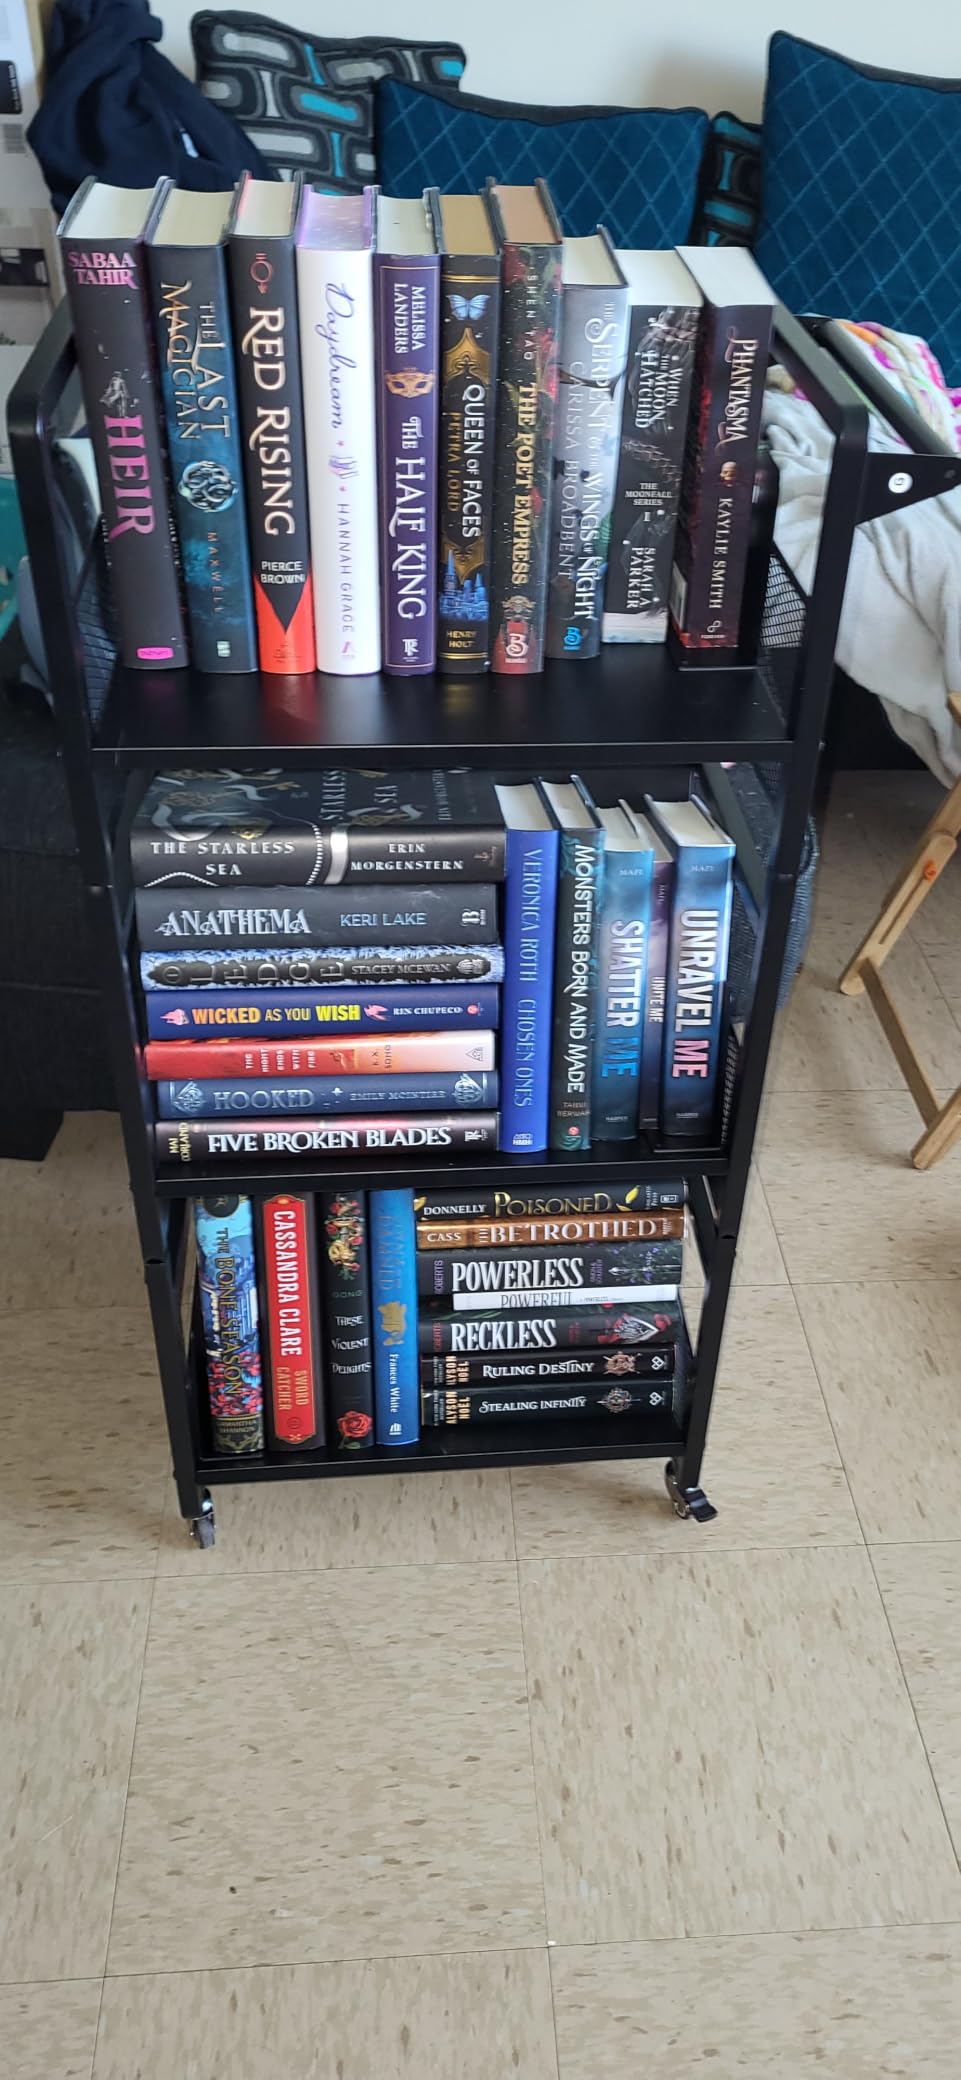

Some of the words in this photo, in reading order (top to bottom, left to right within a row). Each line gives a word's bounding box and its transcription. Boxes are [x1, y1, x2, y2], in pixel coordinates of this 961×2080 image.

[68, 251, 137, 268] SABAA
[73, 269, 139, 290] TAHIR
[526, 275, 538, 318] SHEN
[200, 302, 217, 338] THE
[394, 283, 409, 354] LANDERS
[411, 286, 427, 351] MELISSA
[159, 280, 202, 440] MAGICIAN
[241, 307, 286, 392] RED
[314, 283, 358, 429] Daydream
[524, 331, 537, 361] TAO
[191, 326, 231, 438] LAST
[585, 318, 620, 429] SERPENT
[635, 349, 660, 428] HATCHED
[666, 367, 684, 407] WHEN
[717, 332, 759, 447] PHANTASMA
[517, 382, 540, 426] THE
[565, 361, 586, 449] CARISSA
[650, 372, 669, 421] MOON
[401, 416, 424, 449] THE
[448, 411, 463, 463] PETRA
[462, 384, 486, 454] QUEEN
[104, 415, 156, 539] HEIR
[249, 406, 296, 536] RISING
[514, 432, 538, 489] POET
[388, 457, 427, 537] HALF
[448, 470, 461, 512] LORD
[462, 480, 483, 538] FACES
[579, 472, 603, 543] WINGS
[625, 490, 672, 498] MOONFALL
[633, 498, 663, 506] SERIES
[337, 504, 353, 574] HANNAH
[511, 495, 534, 585] EMPRESS
[557, 460, 581, 580] BROADBENT
[713, 498, 733, 555] KAYLIE
[207, 532, 224, 614] MAXWELL
[260, 574, 305, 584] BROWN
[261, 561, 303, 571] PIERCE
[391, 543, 427, 620] KING
[626, 547, 644, 609] PARKER
[640, 547, 657, 592] SARAH
[709, 560, 727, 609] SMITH
[339, 583, 355, 633] GRACE
[573, 556, 604, 620] NIGHT
[320, 769, 347, 821] STARLESS
[151, 842, 187, 854] THE
[198, 842, 295, 854] STARLESS
[351, 861, 464, 870] MORGENSTERN
[388, 844, 425, 854] ERIN
[206, 864, 242, 875] SEA
[519, 849, 543, 931] VERONICA
[572, 844, 597, 945] MONSTERS
[155, 909, 312, 936] ANATHEMA
[341, 914, 377, 927] KERI
[383, 913, 427, 925] LAKE
[190, 962, 345, 982] LEDGE
[352, 965, 395, 974] STACEY
[397, 963, 451, 973] MCEWAN
[519, 938, 540, 981] ROTH
[563, 951, 591, 997] BORN
[606, 920, 645, 1028] SHATTER
[675, 910, 720, 1033] UNRAVEL
[413, 1006, 463, 1014] CHUPECO
[650, 976, 666, 1004] UNITE
[191, 1007, 261, 1024] WICKED
[265, 1009, 282, 1021] AS
[284, 1008, 311, 1020] YOU
[315, 1005, 361, 1021] WISH
[516, 999, 537, 1062] CHOSEN
[569, 1002, 589, 1039] AND
[648, 1008, 664, 1023] ME
[245, 1053, 254, 1069] THE
[292, 1049, 301, 1070] WITH
[564, 1044, 588, 1093] MADE
[601, 1037, 641, 1078] ME
[672, 1040, 710, 1078] ME
[213, 1089, 315, 1110] HOOKED
[514, 1066, 534, 1107] ONES
[168, 1138, 179, 1153] MAI
[208, 1134, 258, 1152] FIVE
[264, 1131, 359, 1153] BROKEN
[366, 1127, 452, 1147] BLADES
[423, 1204, 487, 1216] DONNELLY
[494, 1191, 612, 1217] POISONED
[215, 1228, 229, 1254] THE
[427, 1232, 462, 1242] CASS
[491, 1219, 657, 1243] BETROTHED
[273, 1210, 300, 1304] CASSANDRA
[451, 1258, 584, 1292] POWERLESS
[214, 1256, 238, 1312] BONE
[501, 1291, 574, 1308] POWERFUL
[278, 1308, 303, 1356] CLARE
[335, 1315, 364, 1326] THESE
[450, 1319, 557, 1352] RECKLESS
[219, 1315, 243, 1395] SEASON
[388, 1353, 400, 1383] Frances
[483, 1365, 536, 1378] RULING
[539, 1359, 595, 1374] DESTINY
[276, 1367, 292, 1411] CATCHER
[294, 1369, 309, 1406] SWORD
[388, 1386, 400, 1413] White
[445, 1391, 459, 1424] ALYSON
[479, 1401, 539, 1414] STEALING
[540, 1395, 588, 1409] INFINITY
